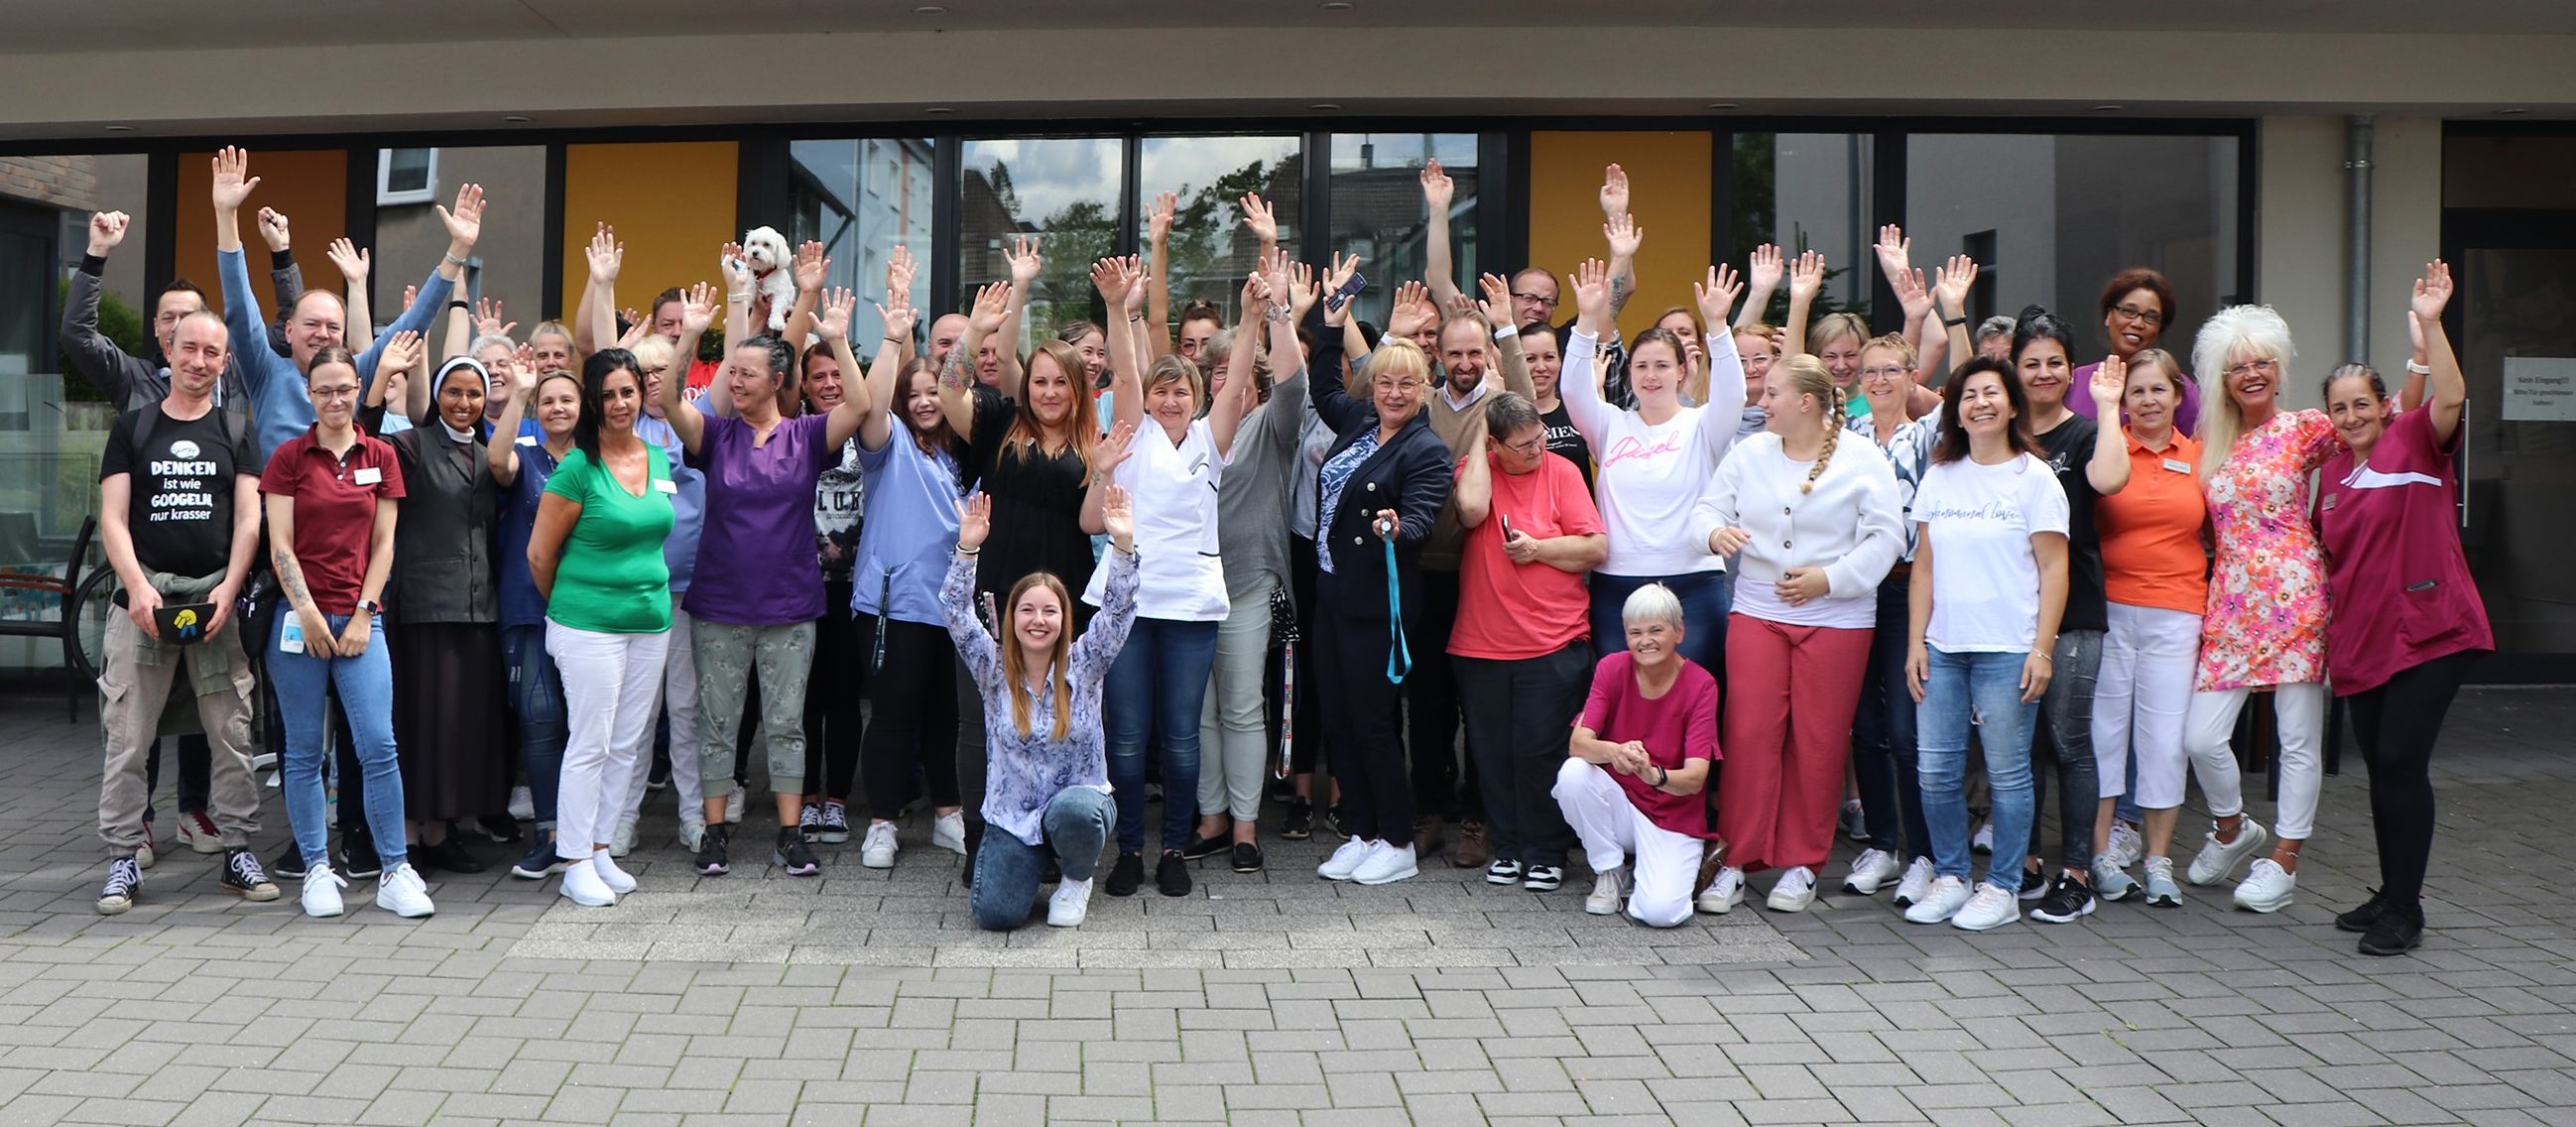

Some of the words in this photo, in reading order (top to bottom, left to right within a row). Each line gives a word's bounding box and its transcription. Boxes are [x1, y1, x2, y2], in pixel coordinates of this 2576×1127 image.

[151, 460, 217, 475] DENKEN
[164, 477, 179, 489] ist
[180, 477, 201, 489] wie
[150, 511, 170, 522] nur
[171, 508, 211, 521] krasser
